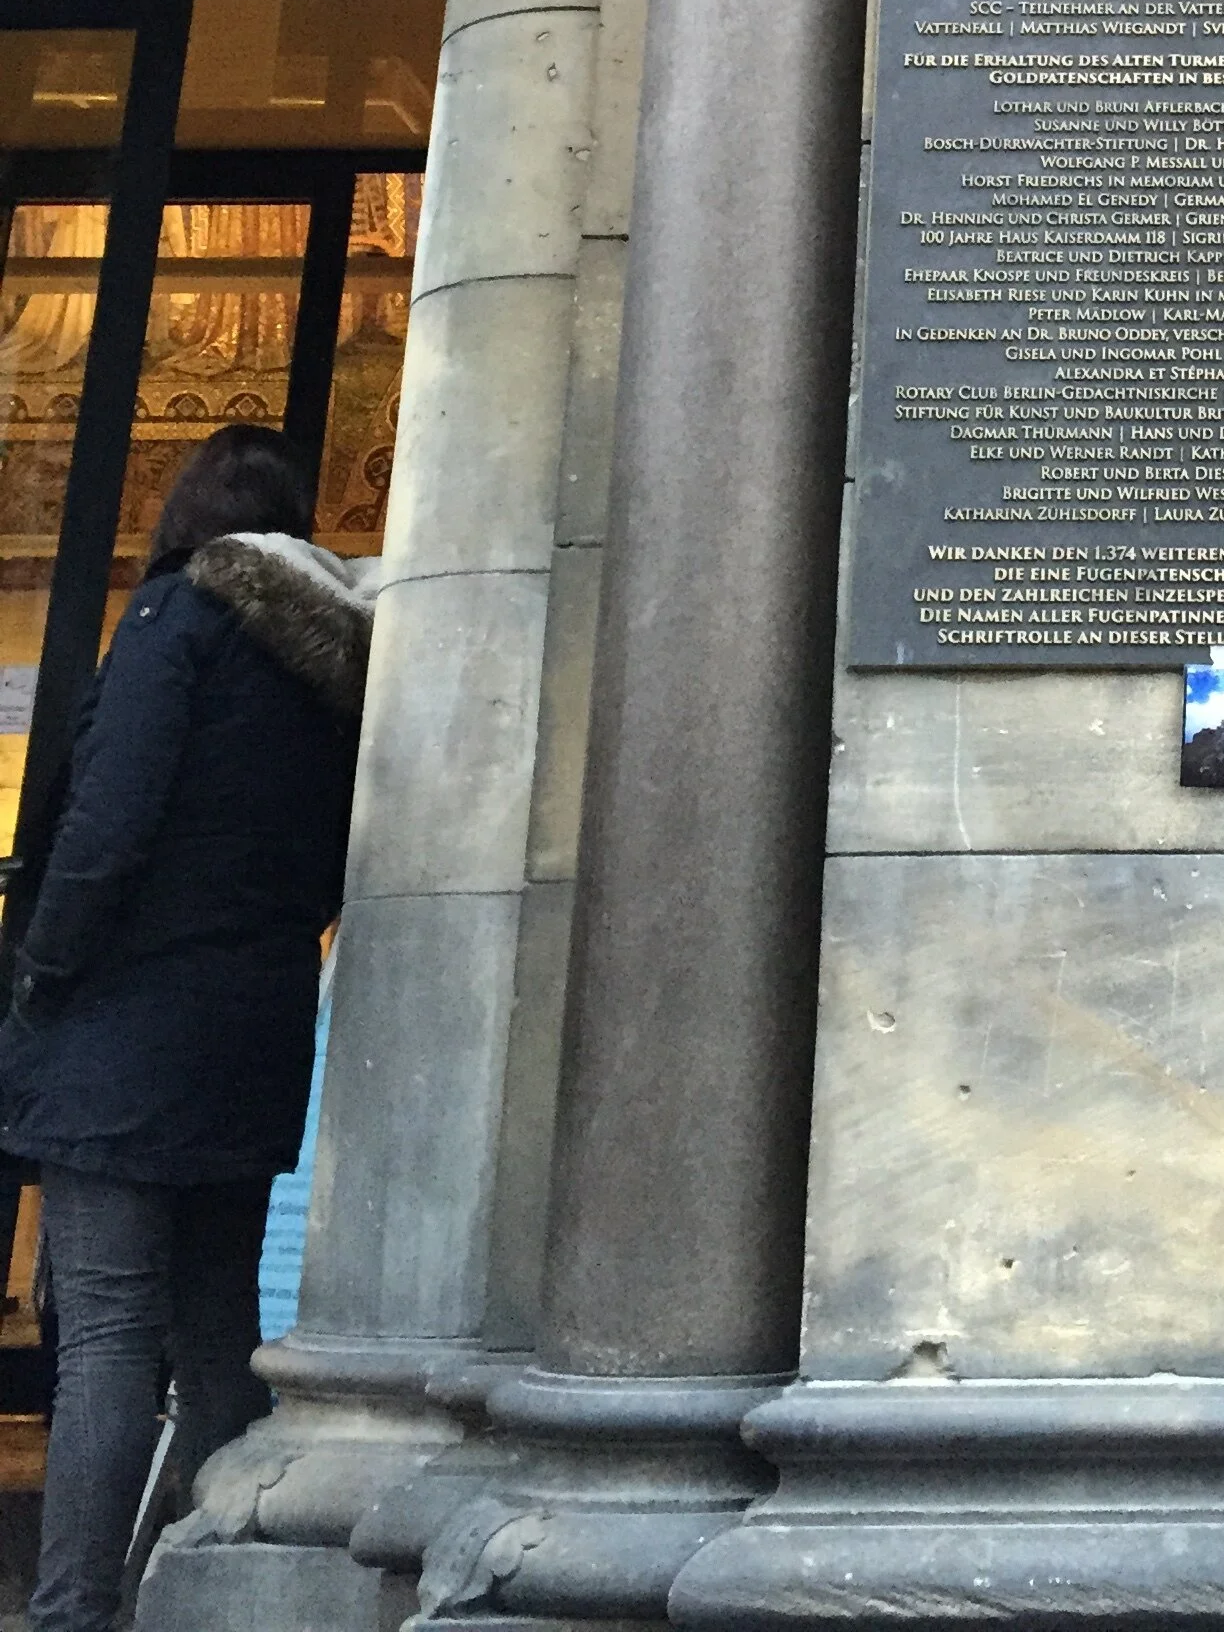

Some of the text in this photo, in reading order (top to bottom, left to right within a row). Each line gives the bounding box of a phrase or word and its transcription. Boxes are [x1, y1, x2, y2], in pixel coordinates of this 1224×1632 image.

[940, 53, 969, 66] DIE
[973, 53, 1074, 67] ERHALTUNG
[1078, 54, 1109, 67] DES
[1111, 53, 1165, 67] ALTEN
[988, 70, 1174, 84] GOLDPATENSCHAFTEN
[1178, 71, 1199, 84] IN
[928, 543, 968, 560] WIR
[971, 546, 1047, 561] DANKEN
[1051, 546, 1089, 560] DEN
[994, 567, 1025, 581] DIE
[1030, 567, 1071, 581] EINE
[913, 587, 955, 602] UND
[959, 588, 997, 602] DEN
[1001, 588, 1129, 602] ZAHLREICHEN
[919, 606, 953, 622] DIE
[957, 607, 1024, 623] NAMEN
[1027, 609, 1084, 623] ALLER
[937, 628, 1073, 644] SCHRIFTROLLE
[1076, 630, 1103, 644] AN
[1108, 629, 1172, 644] DIESER
